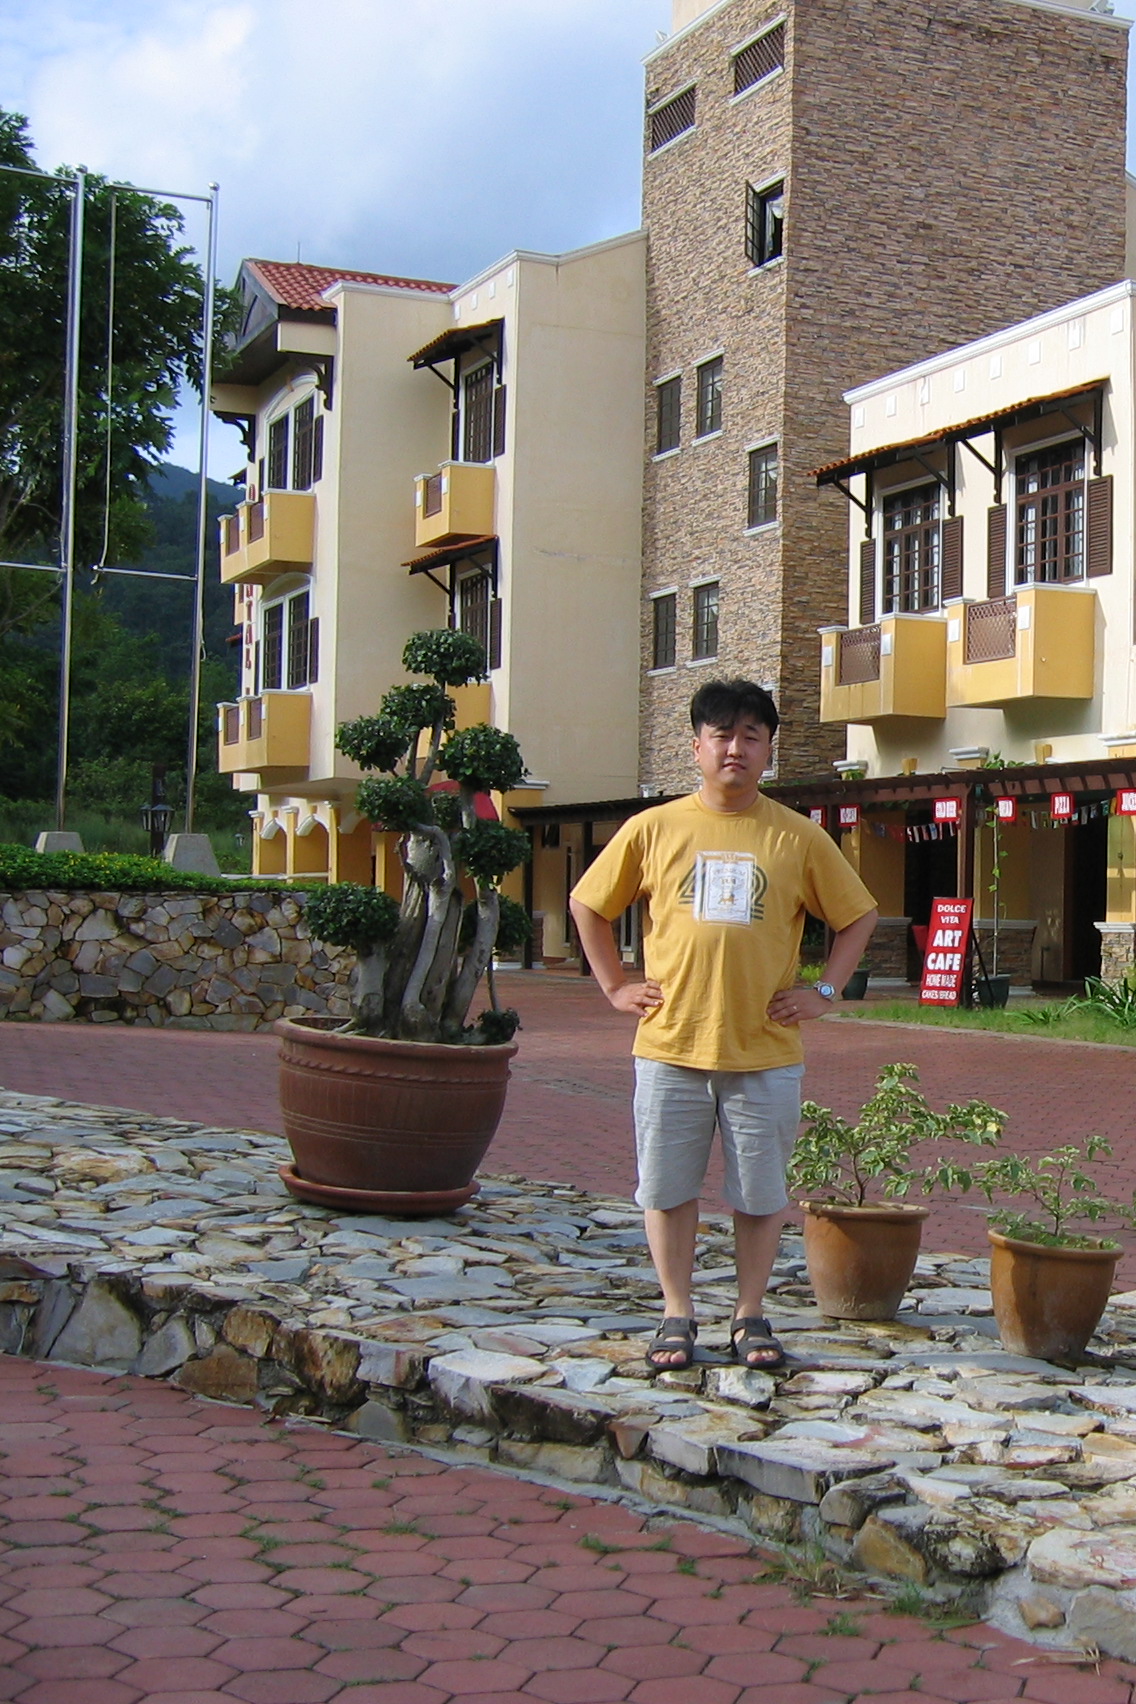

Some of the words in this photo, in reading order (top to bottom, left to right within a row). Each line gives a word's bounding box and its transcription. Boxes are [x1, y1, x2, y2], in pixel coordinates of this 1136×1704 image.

[937, 904, 967, 913] DOLCE
[940, 916, 960, 924] VITA
[933, 929, 963, 947] ART
[927, 952, 961, 971] CAFE
